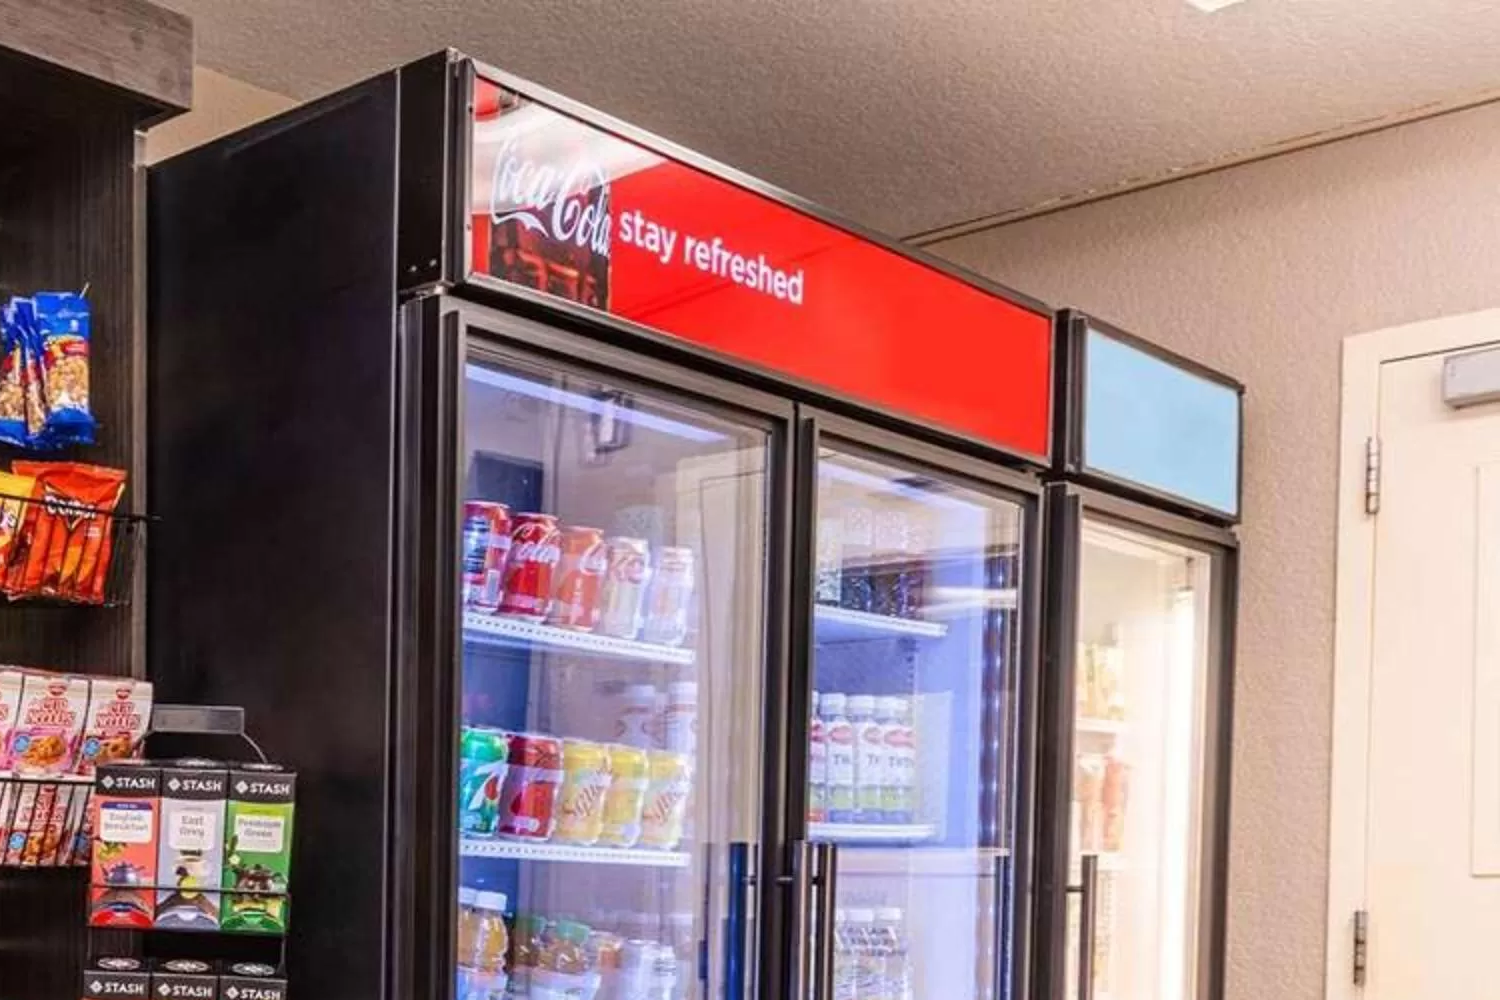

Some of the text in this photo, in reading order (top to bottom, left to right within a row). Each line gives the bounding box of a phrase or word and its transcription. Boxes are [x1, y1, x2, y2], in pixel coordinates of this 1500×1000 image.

[619, 210, 805, 305] stay refreshed
[113, 777, 156, 790] STASH
[181, 779, 223, 792] STASH
[249, 783, 291, 795] STASH
[103, 982, 145, 994] STASH
[171, 984, 213, 996] STASH
[239, 988, 281, 1000] STASH
